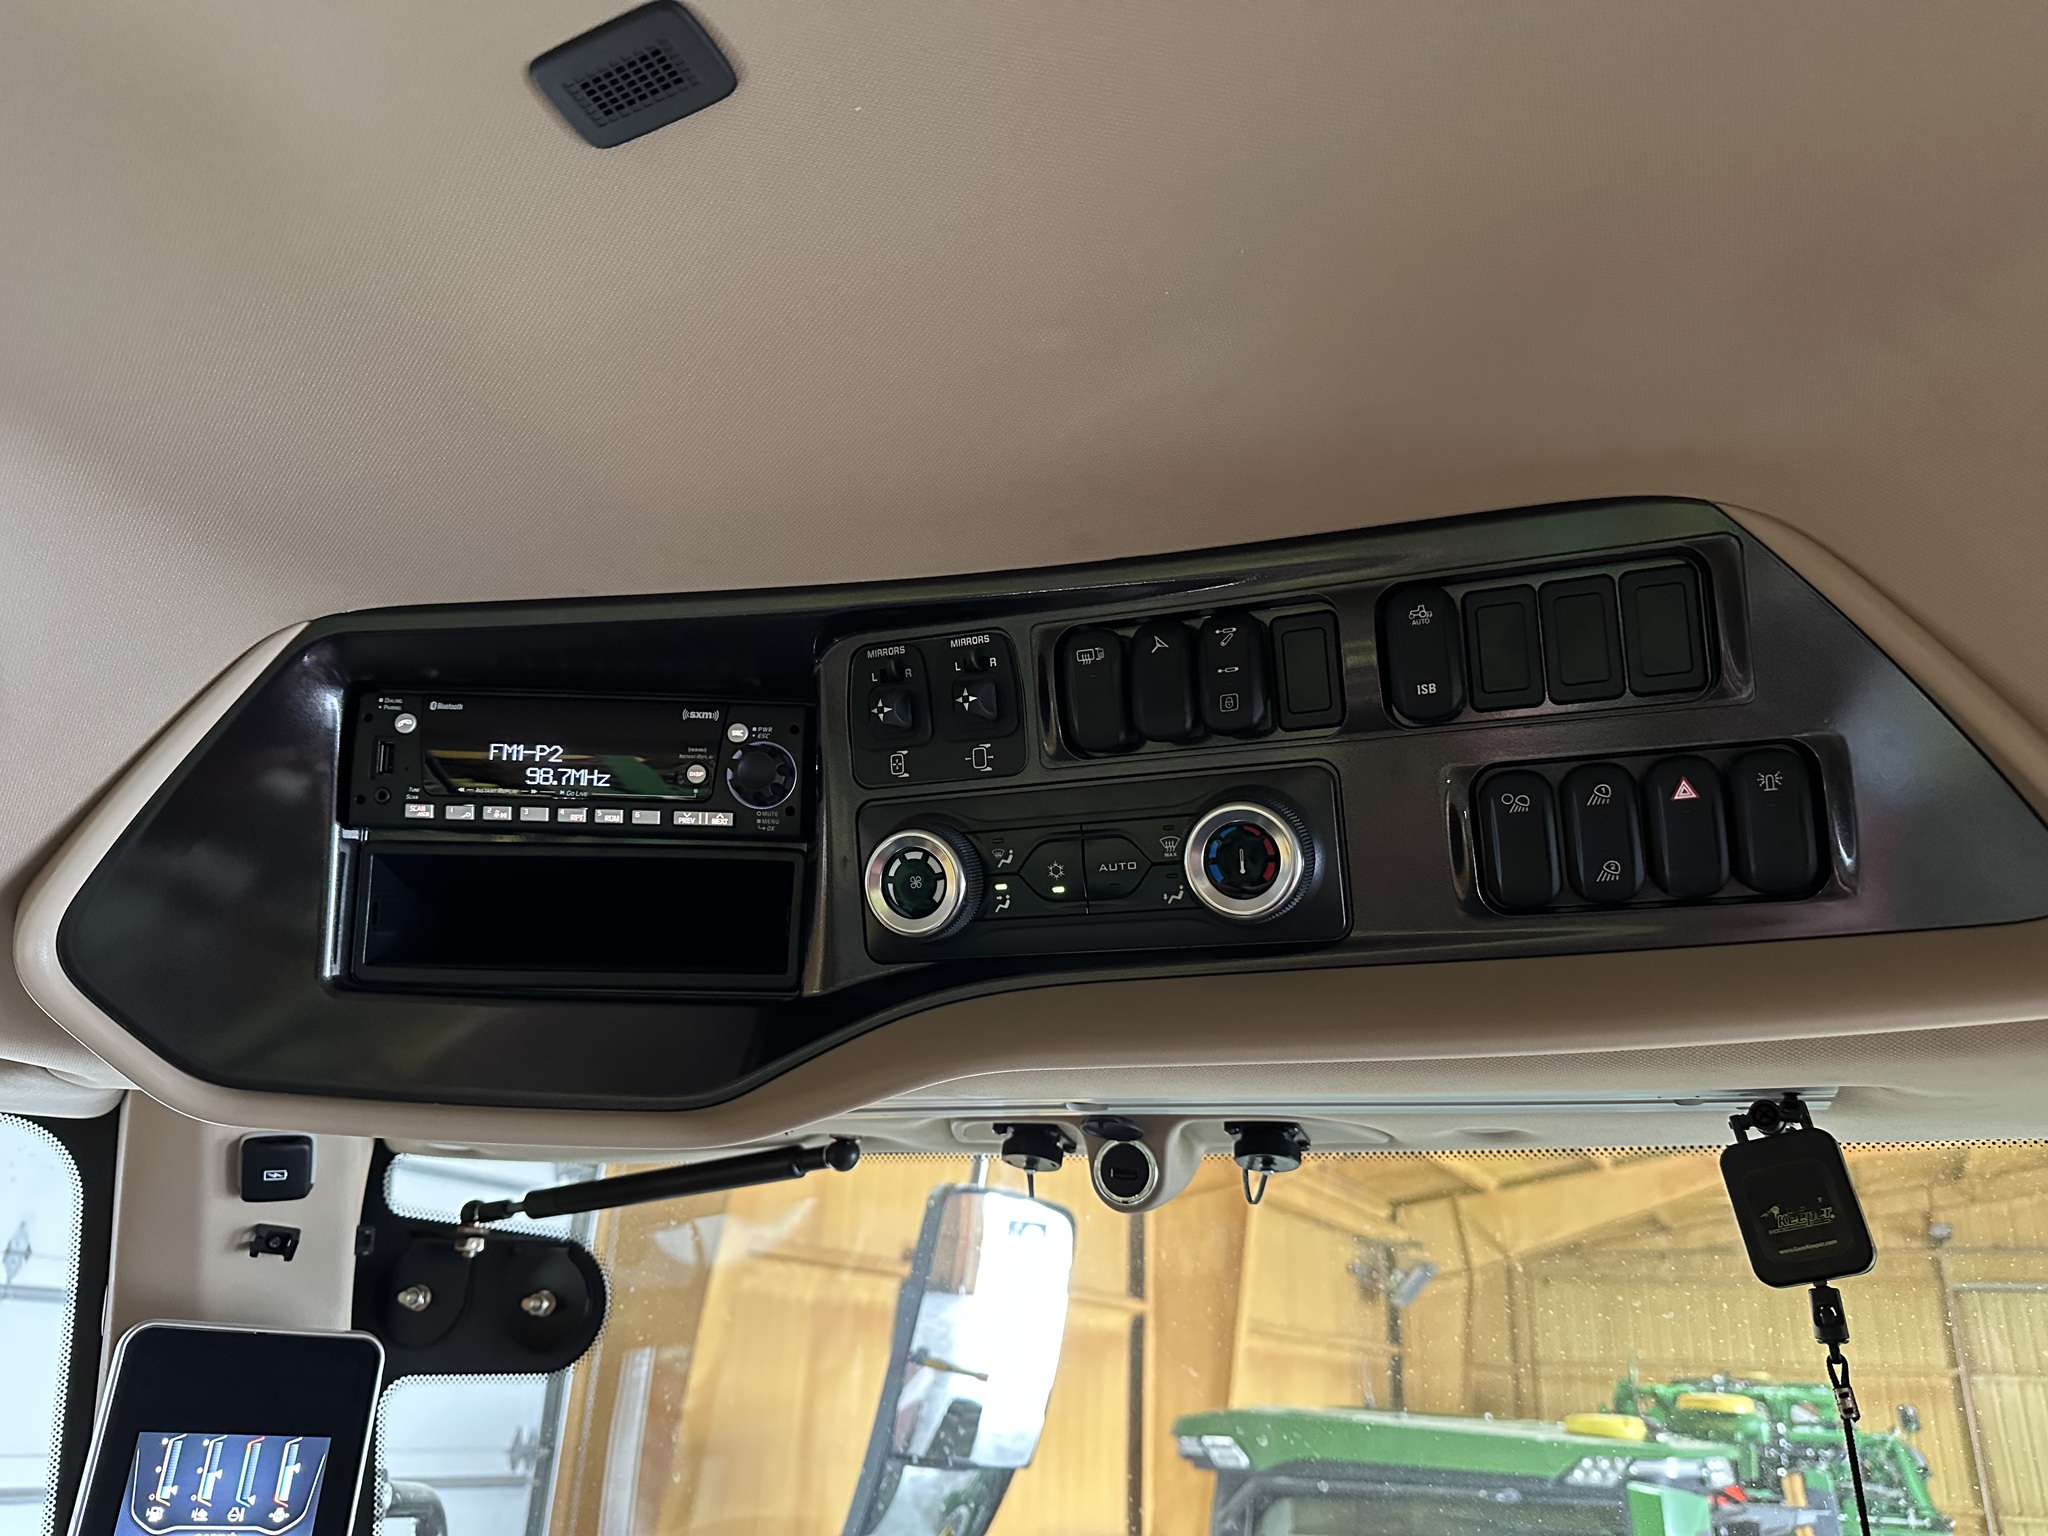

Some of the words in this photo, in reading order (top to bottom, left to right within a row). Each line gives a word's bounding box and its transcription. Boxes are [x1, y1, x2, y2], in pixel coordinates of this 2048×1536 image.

[1412, 618, 1430, 626] AUTO
[950, 634, 990, 648] MIRRORS
[867, 645, 906, 659] MIRRORS
[955, 662, 961, 671] L
[989, 657, 997, 667] R
[872, 673, 878, 682] L
[905, 669, 912, 678] R
[1417, 683, 1437, 695] ISB
[489, 743, 564, 763] FM1-P2
[525, 767, 611, 787] 98.7MHz
[570, 813, 584, 821] RPT
[604, 814, 620, 822] RDM
[678, 817, 696, 825] PREV
[711, 818, 729, 826] NEXT
[1099, 861, 1137, 872] AUTO
